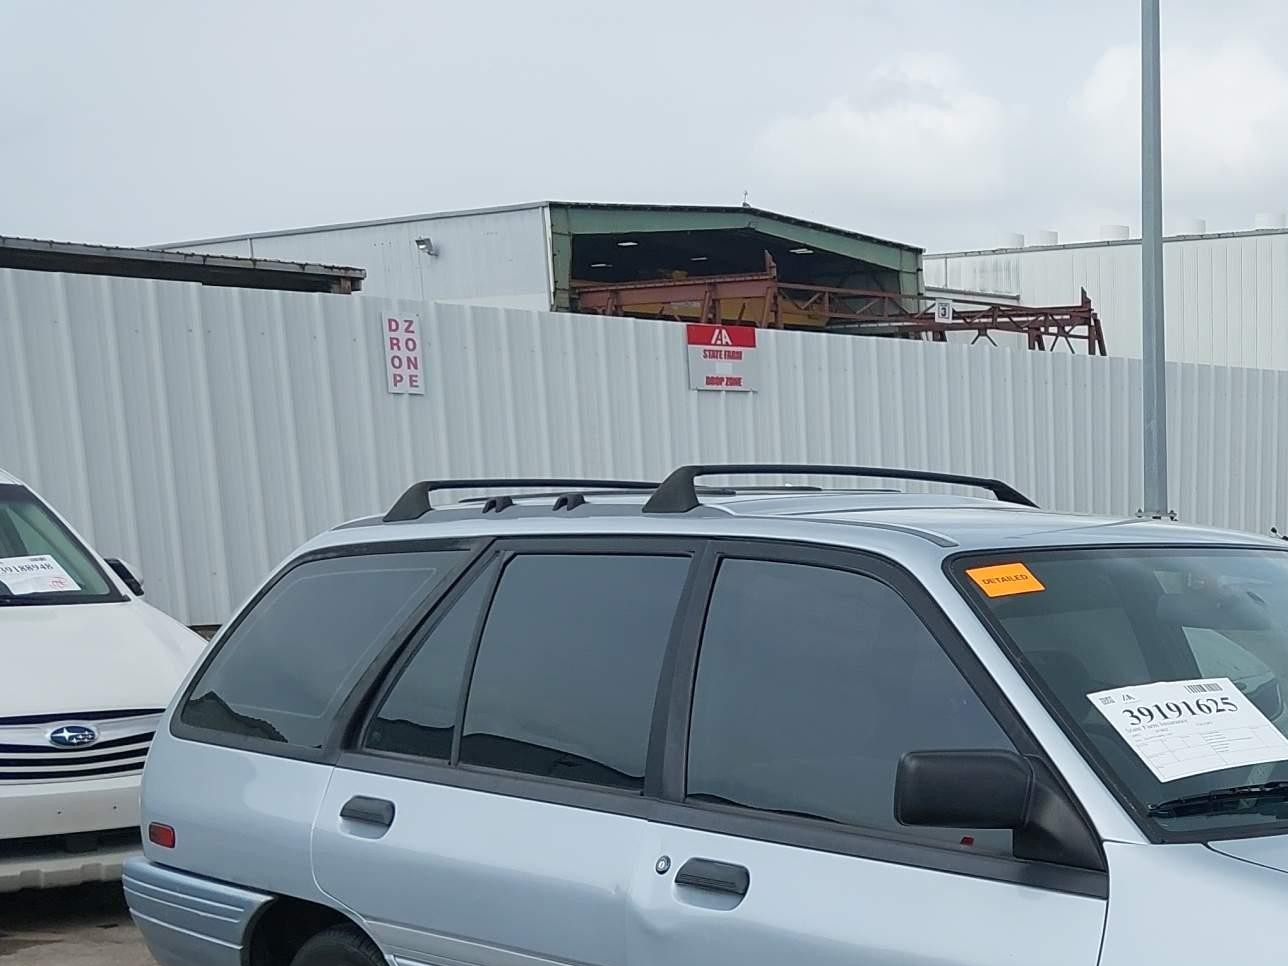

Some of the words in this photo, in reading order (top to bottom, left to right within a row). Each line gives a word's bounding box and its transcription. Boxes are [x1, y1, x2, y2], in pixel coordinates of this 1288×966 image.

[703, 349, 723, 360] STATE
[705, 375, 724, 386] DROP
[725, 376, 743, 387] ZONE
[981, 574, 1029, 585] DETAILED
[1122, 697, 1239, 726] 39191625
